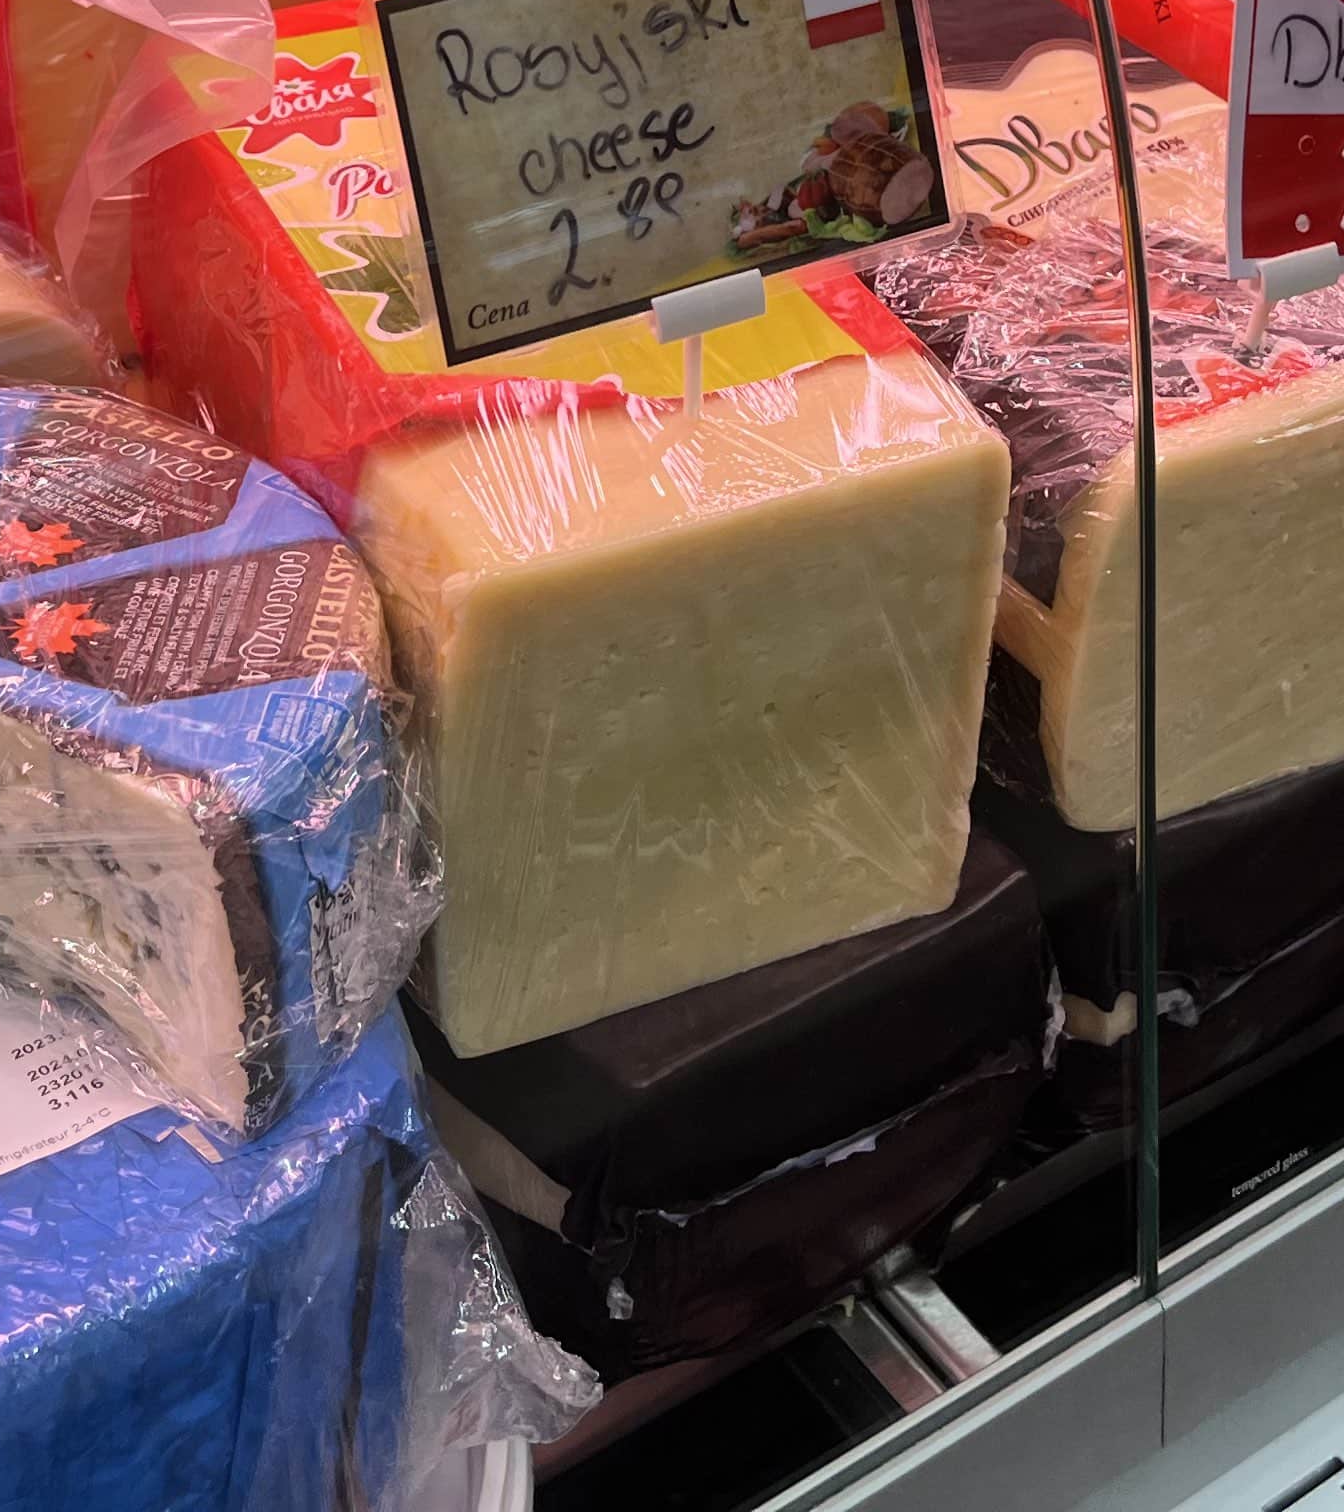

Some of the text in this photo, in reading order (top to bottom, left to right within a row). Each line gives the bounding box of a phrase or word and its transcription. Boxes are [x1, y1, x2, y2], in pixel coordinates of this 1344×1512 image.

[467, 300, 531, 331] Cena
[53, 396, 238, 462] CASTELLO
[43, 419, 238, 492] GORGONZOLA
[114, 485, 145, 505] WITH
[238, 550, 311, 682] GORGONZOLA
[47, 1077, 105, 1111] 3,116
[1231, 1146, 1309, 1198] tempered glass
